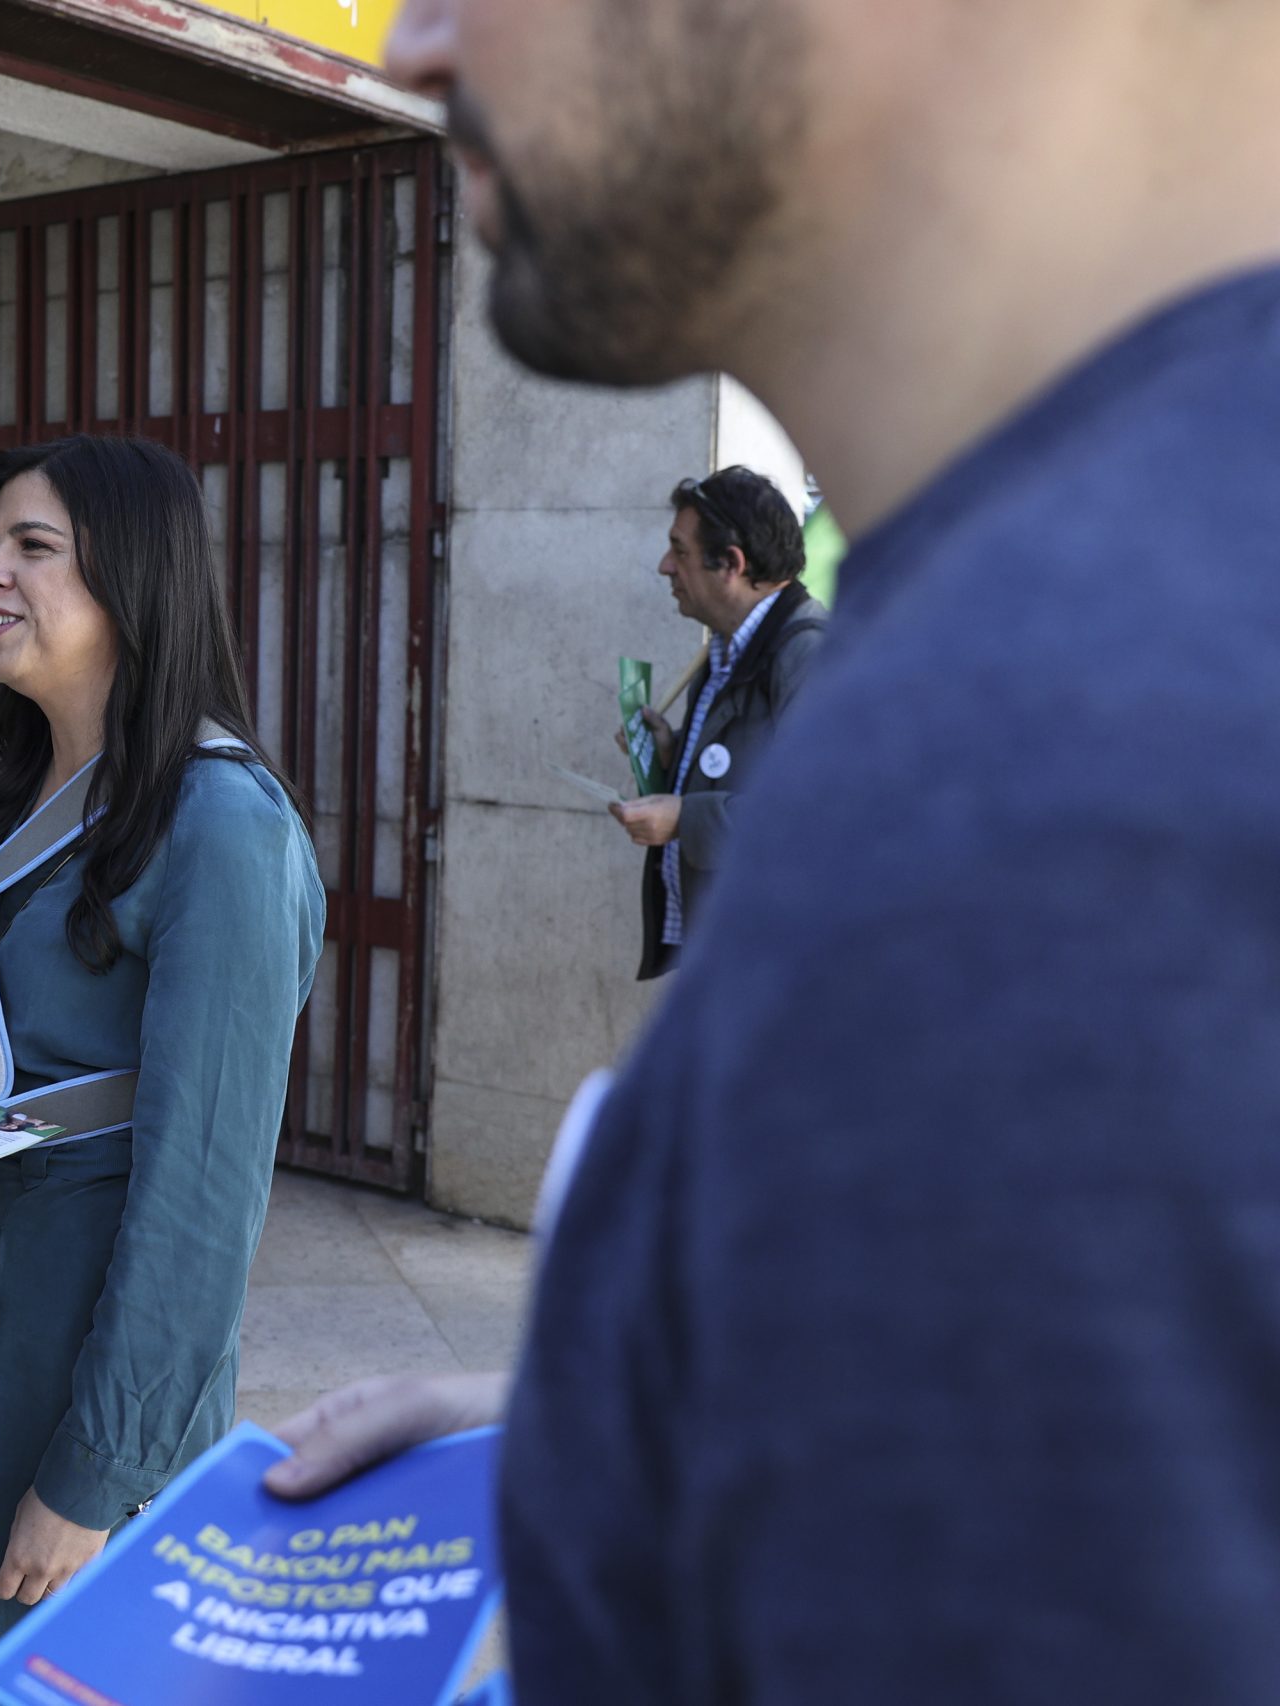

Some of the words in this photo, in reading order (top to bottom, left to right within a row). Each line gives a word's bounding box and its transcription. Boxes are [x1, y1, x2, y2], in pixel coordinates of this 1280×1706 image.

[196, 1524, 359, 1579] BAIXOU
[363, 1537, 473, 1575] MAIS
[289, 1529, 325, 1552] O
[328, 1515, 417, 1548] PAN
[153, 1535, 376, 1609] IMPOSTOS
[380, 1568, 482, 1606] QUE
[152, 1581, 191, 1611] A
[193, 1596, 428, 1640] INICIATIVA
[172, 1622, 363, 1676] LIBERAL
